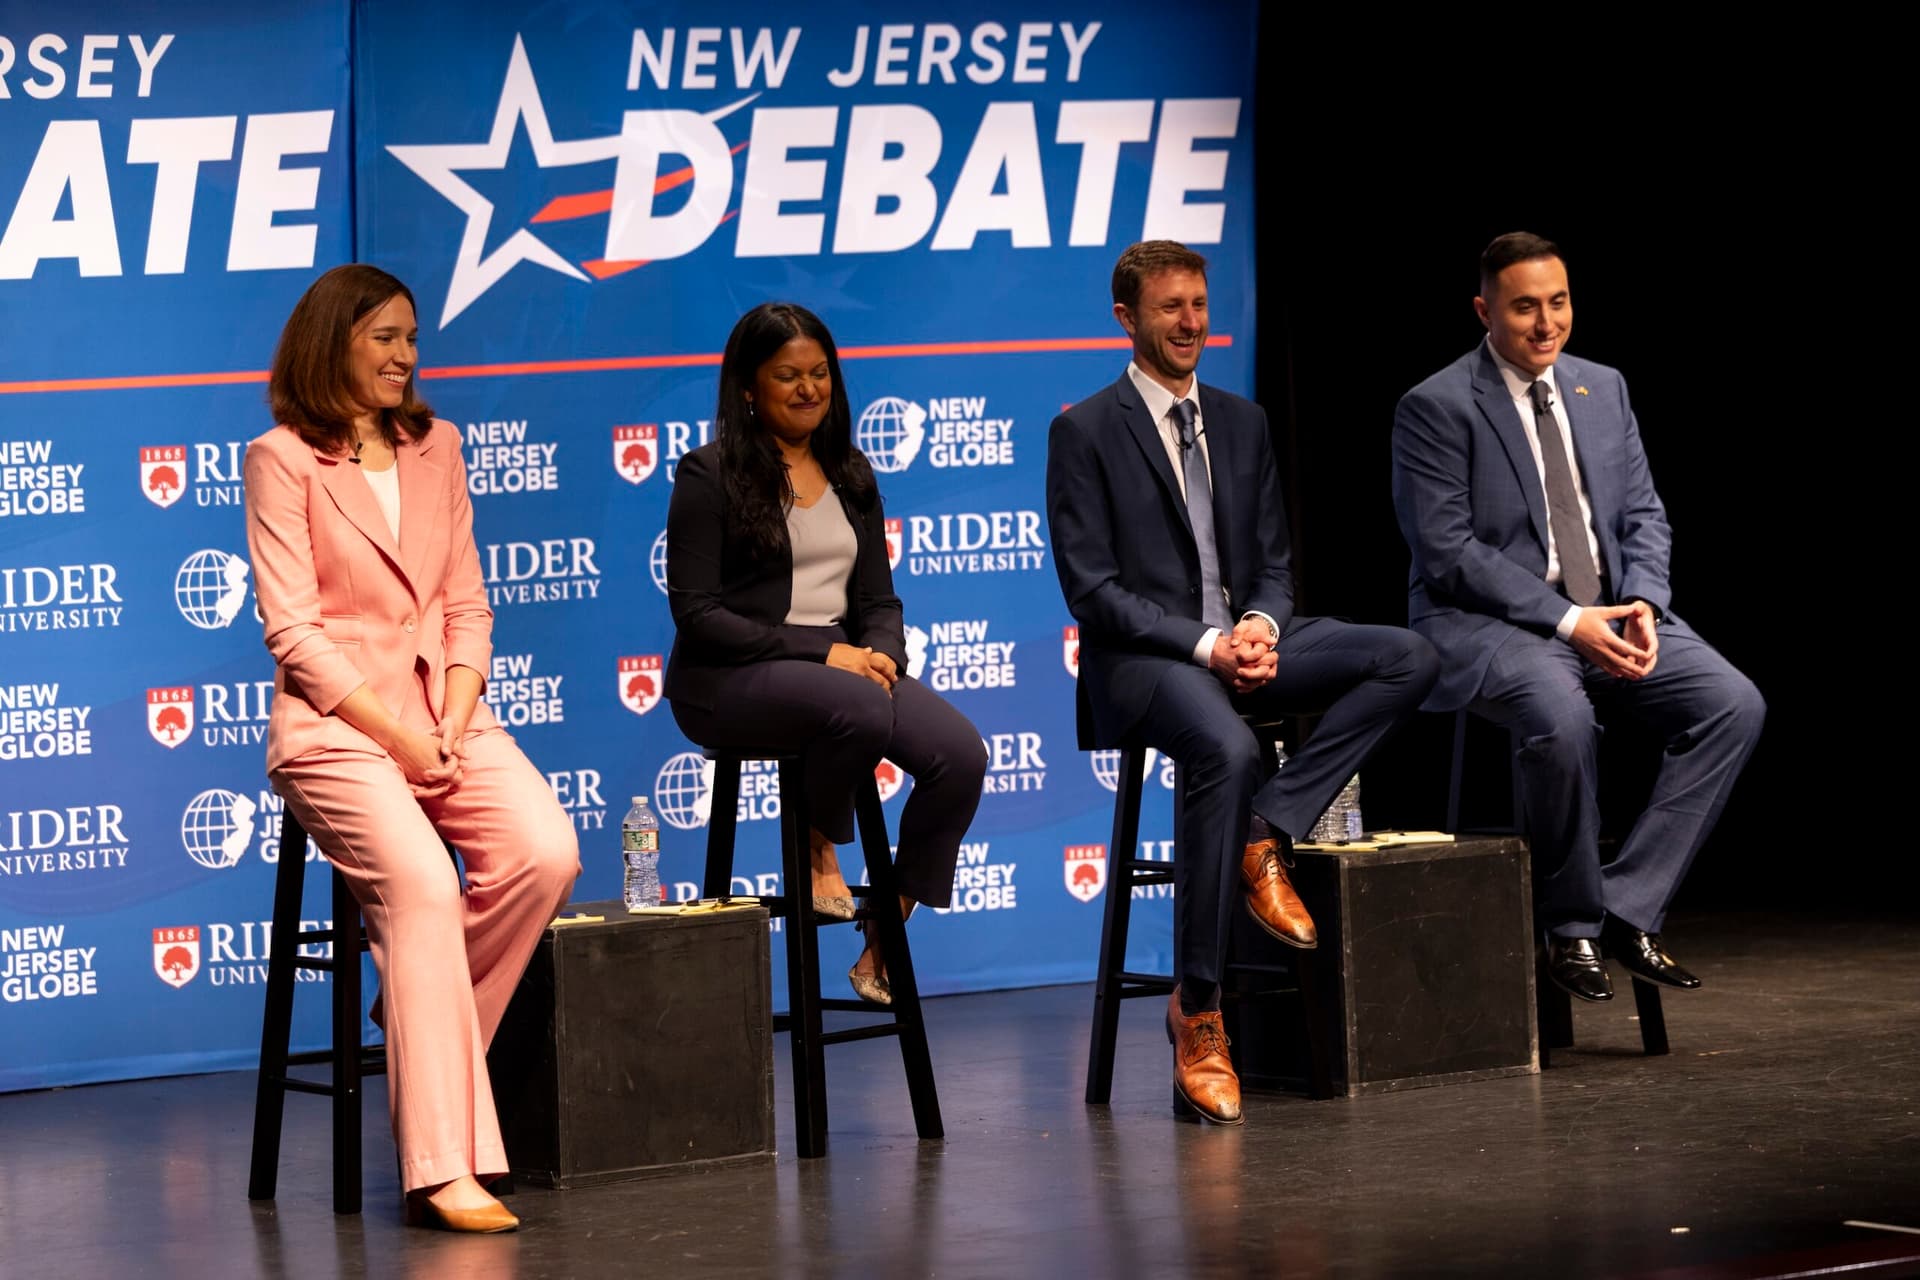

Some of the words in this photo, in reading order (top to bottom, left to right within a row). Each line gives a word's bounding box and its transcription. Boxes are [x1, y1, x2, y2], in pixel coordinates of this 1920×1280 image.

[626, 27, 802, 91] NEW
[827, 21, 1102, 88] JERSEY
[604, 97, 1241, 261] DEBATE
[0, 109, 335, 279] ATE
[929, 396, 986, 421] NEW
[467, 420, 528, 446] NEW
[928, 418, 1014, 445] JERSEY
[145, 447, 181, 463] 1865
[467, 442, 558, 471] JERSEY
[929, 441, 1014, 468] GLOBE
[0, 464, 84, 490] ERSEY
[468, 466, 559, 495] GLOBE
[909, 511, 1046, 554] RIDER
[487, 537, 601, 583] IDER
[909, 553, 1046, 576] UNIVERSITY
[0, 563, 123, 608] IDER
[486, 579, 600, 606] IVERSITY
[931, 620, 988, 645] NEW
[487, 653, 532, 679] EW
[930, 641, 1016, 668] JERSEY
[480, 674, 563, 704] ERSEY
[931, 664, 1017, 692] GLOBE
[0, 682, 59, 709] NEW
[151, 688, 189, 702] 1865
[0, 705, 91, 735] JERSEY
[493, 697, 564, 727] LOBE
[0, 730, 92, 760] GLOBE
[983, 771, 1046, 794] RSITY
[0, 804, 129, 852] IDER
[933, 885, 1017, 915] LOBE
[1, 924, 65, 953] NEW
[158, 928, 195, 943] 1865
[1, 947, 97, 978] JERSEY
[2, 970, 98, 1003] GLOBE
